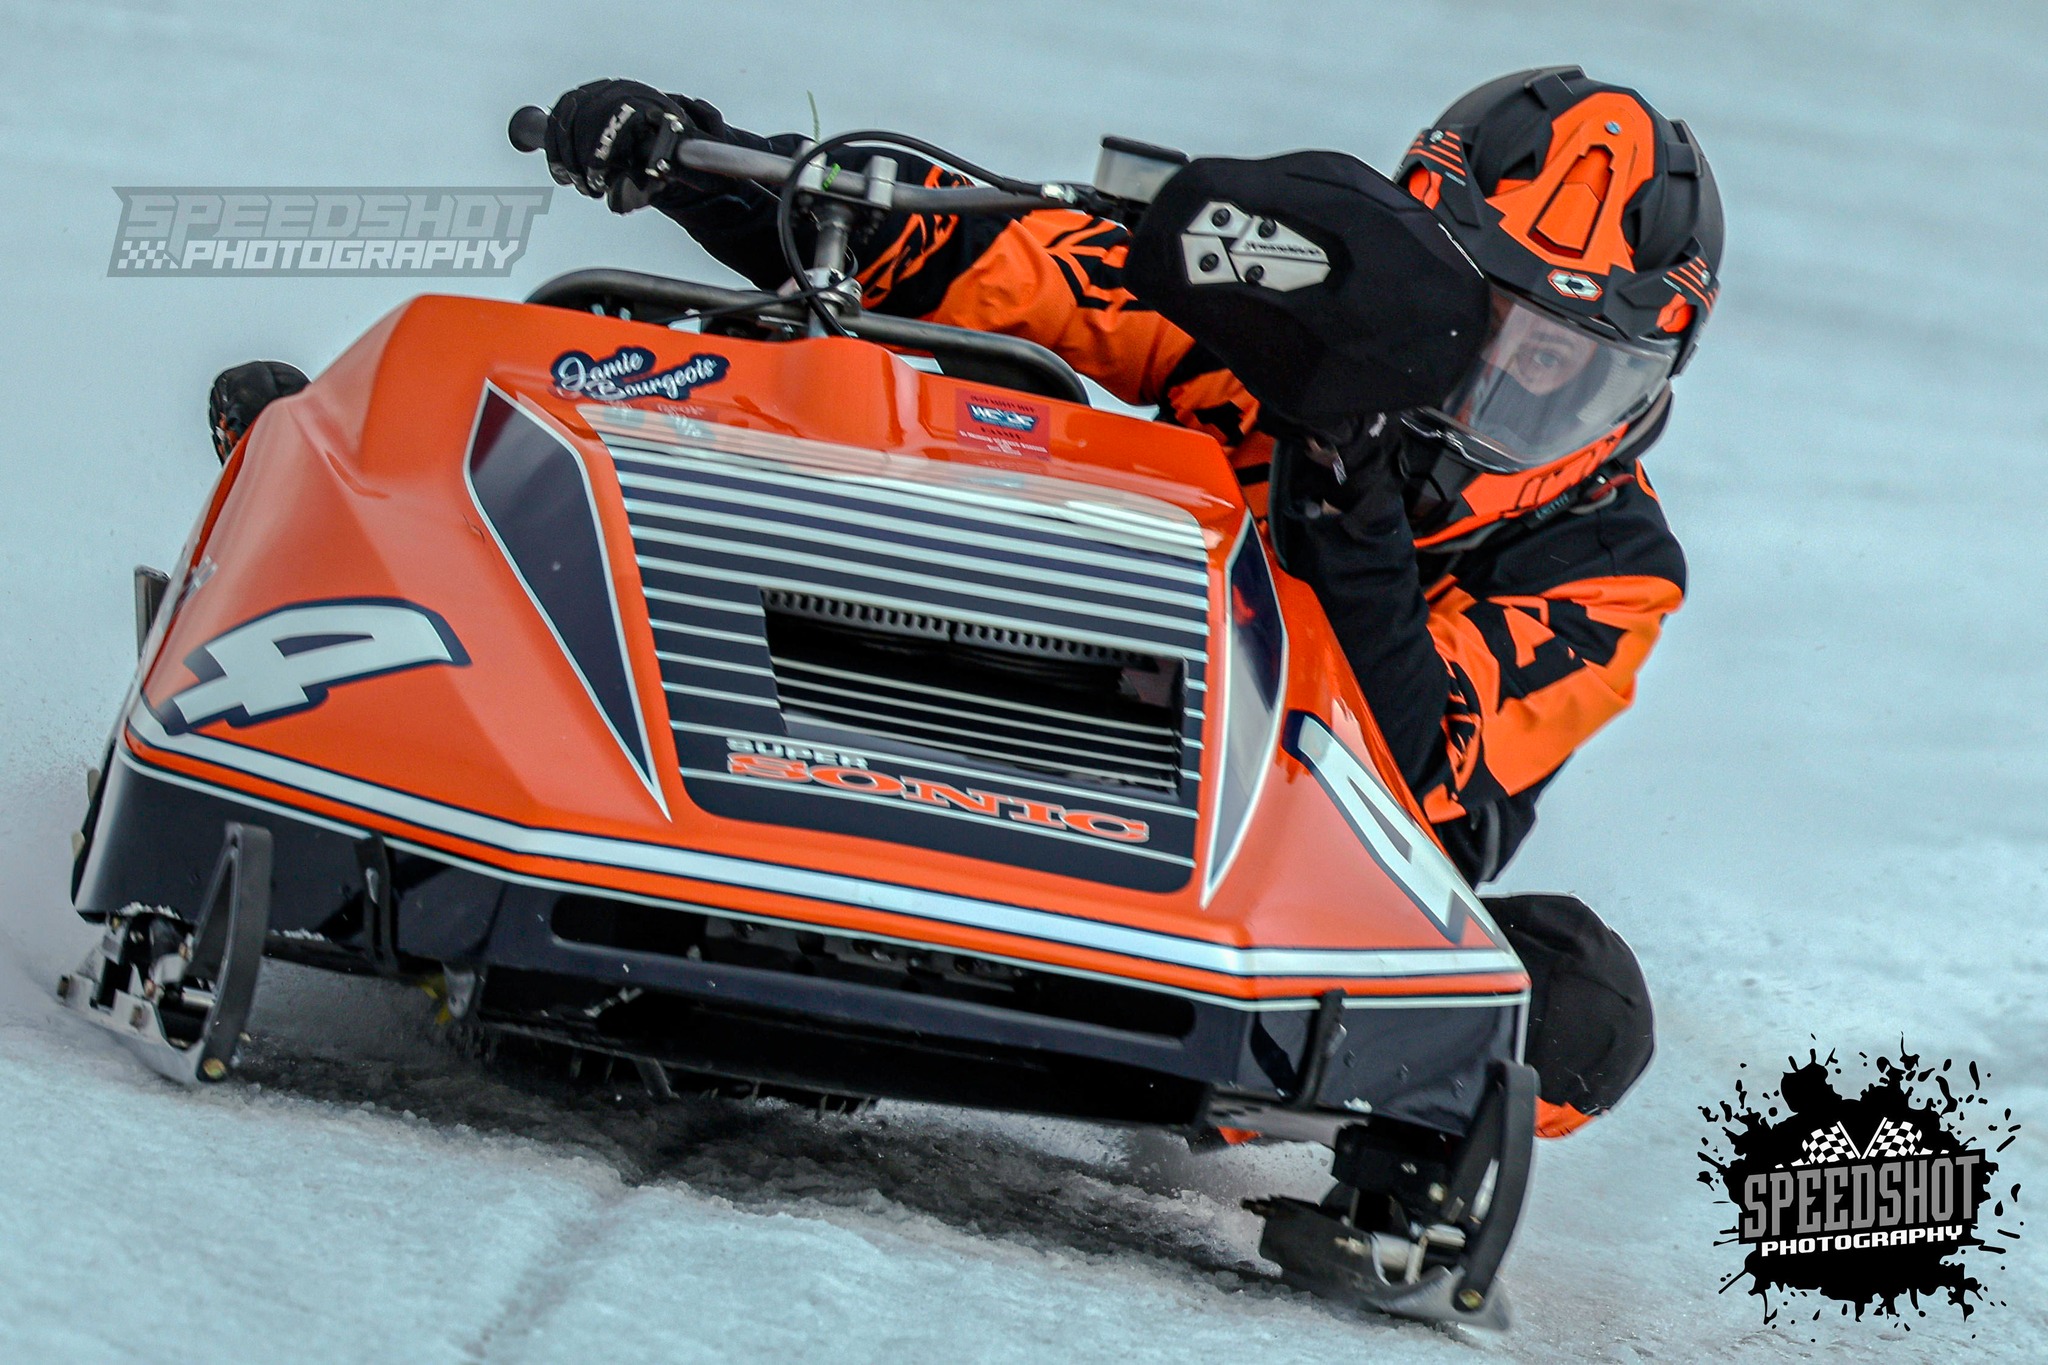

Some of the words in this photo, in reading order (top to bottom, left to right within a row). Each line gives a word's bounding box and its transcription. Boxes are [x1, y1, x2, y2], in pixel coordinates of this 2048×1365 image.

[557, 352, 645, 392] Jamie
[586, 358, 718, 401] Bourgeois
[164, 599, 466, 731] 4
[726, 737, 868, 769] SUPER
[727, 752, 1150, 843] SONIC
